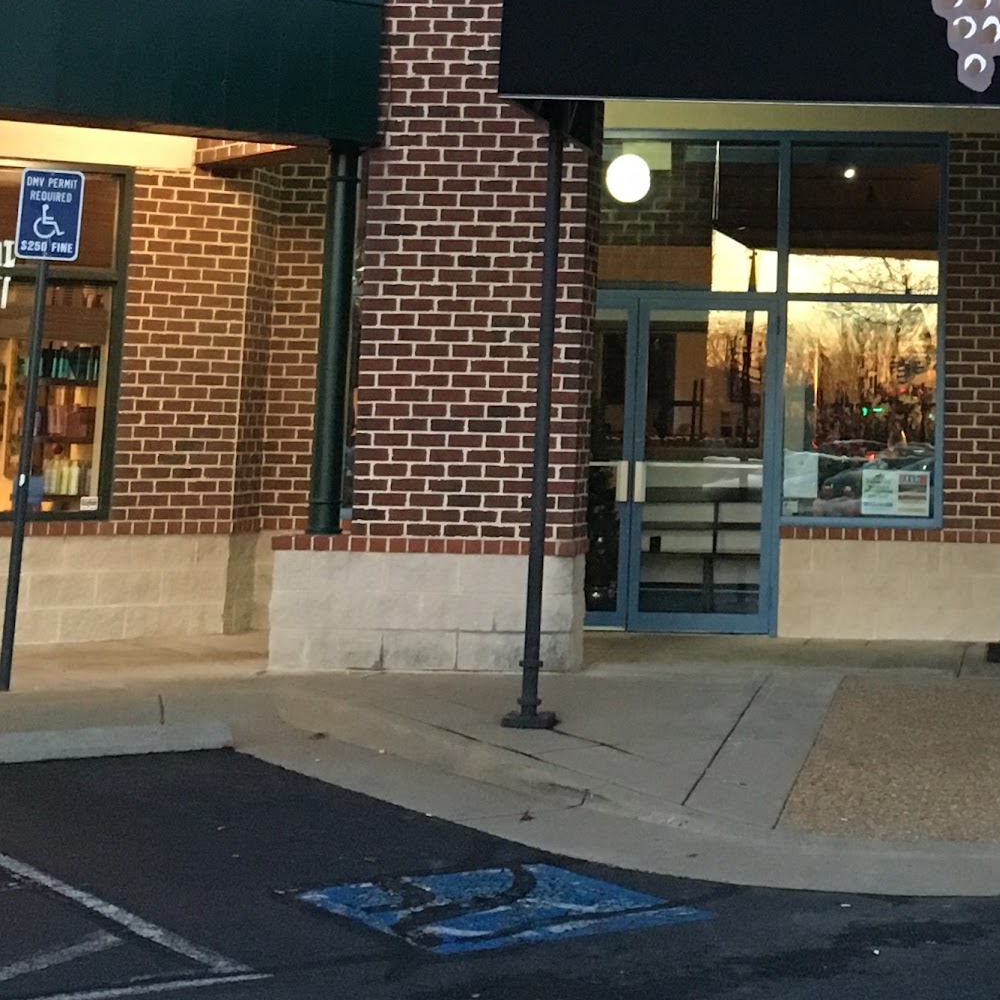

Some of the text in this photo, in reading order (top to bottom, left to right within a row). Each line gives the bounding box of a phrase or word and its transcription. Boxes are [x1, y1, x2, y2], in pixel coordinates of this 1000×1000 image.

[26, 176, 79, 189] DMV PERMIT
[29, 190, 73, 203] REQUIRED
[20, 240, 74, 254] $250 FINE
